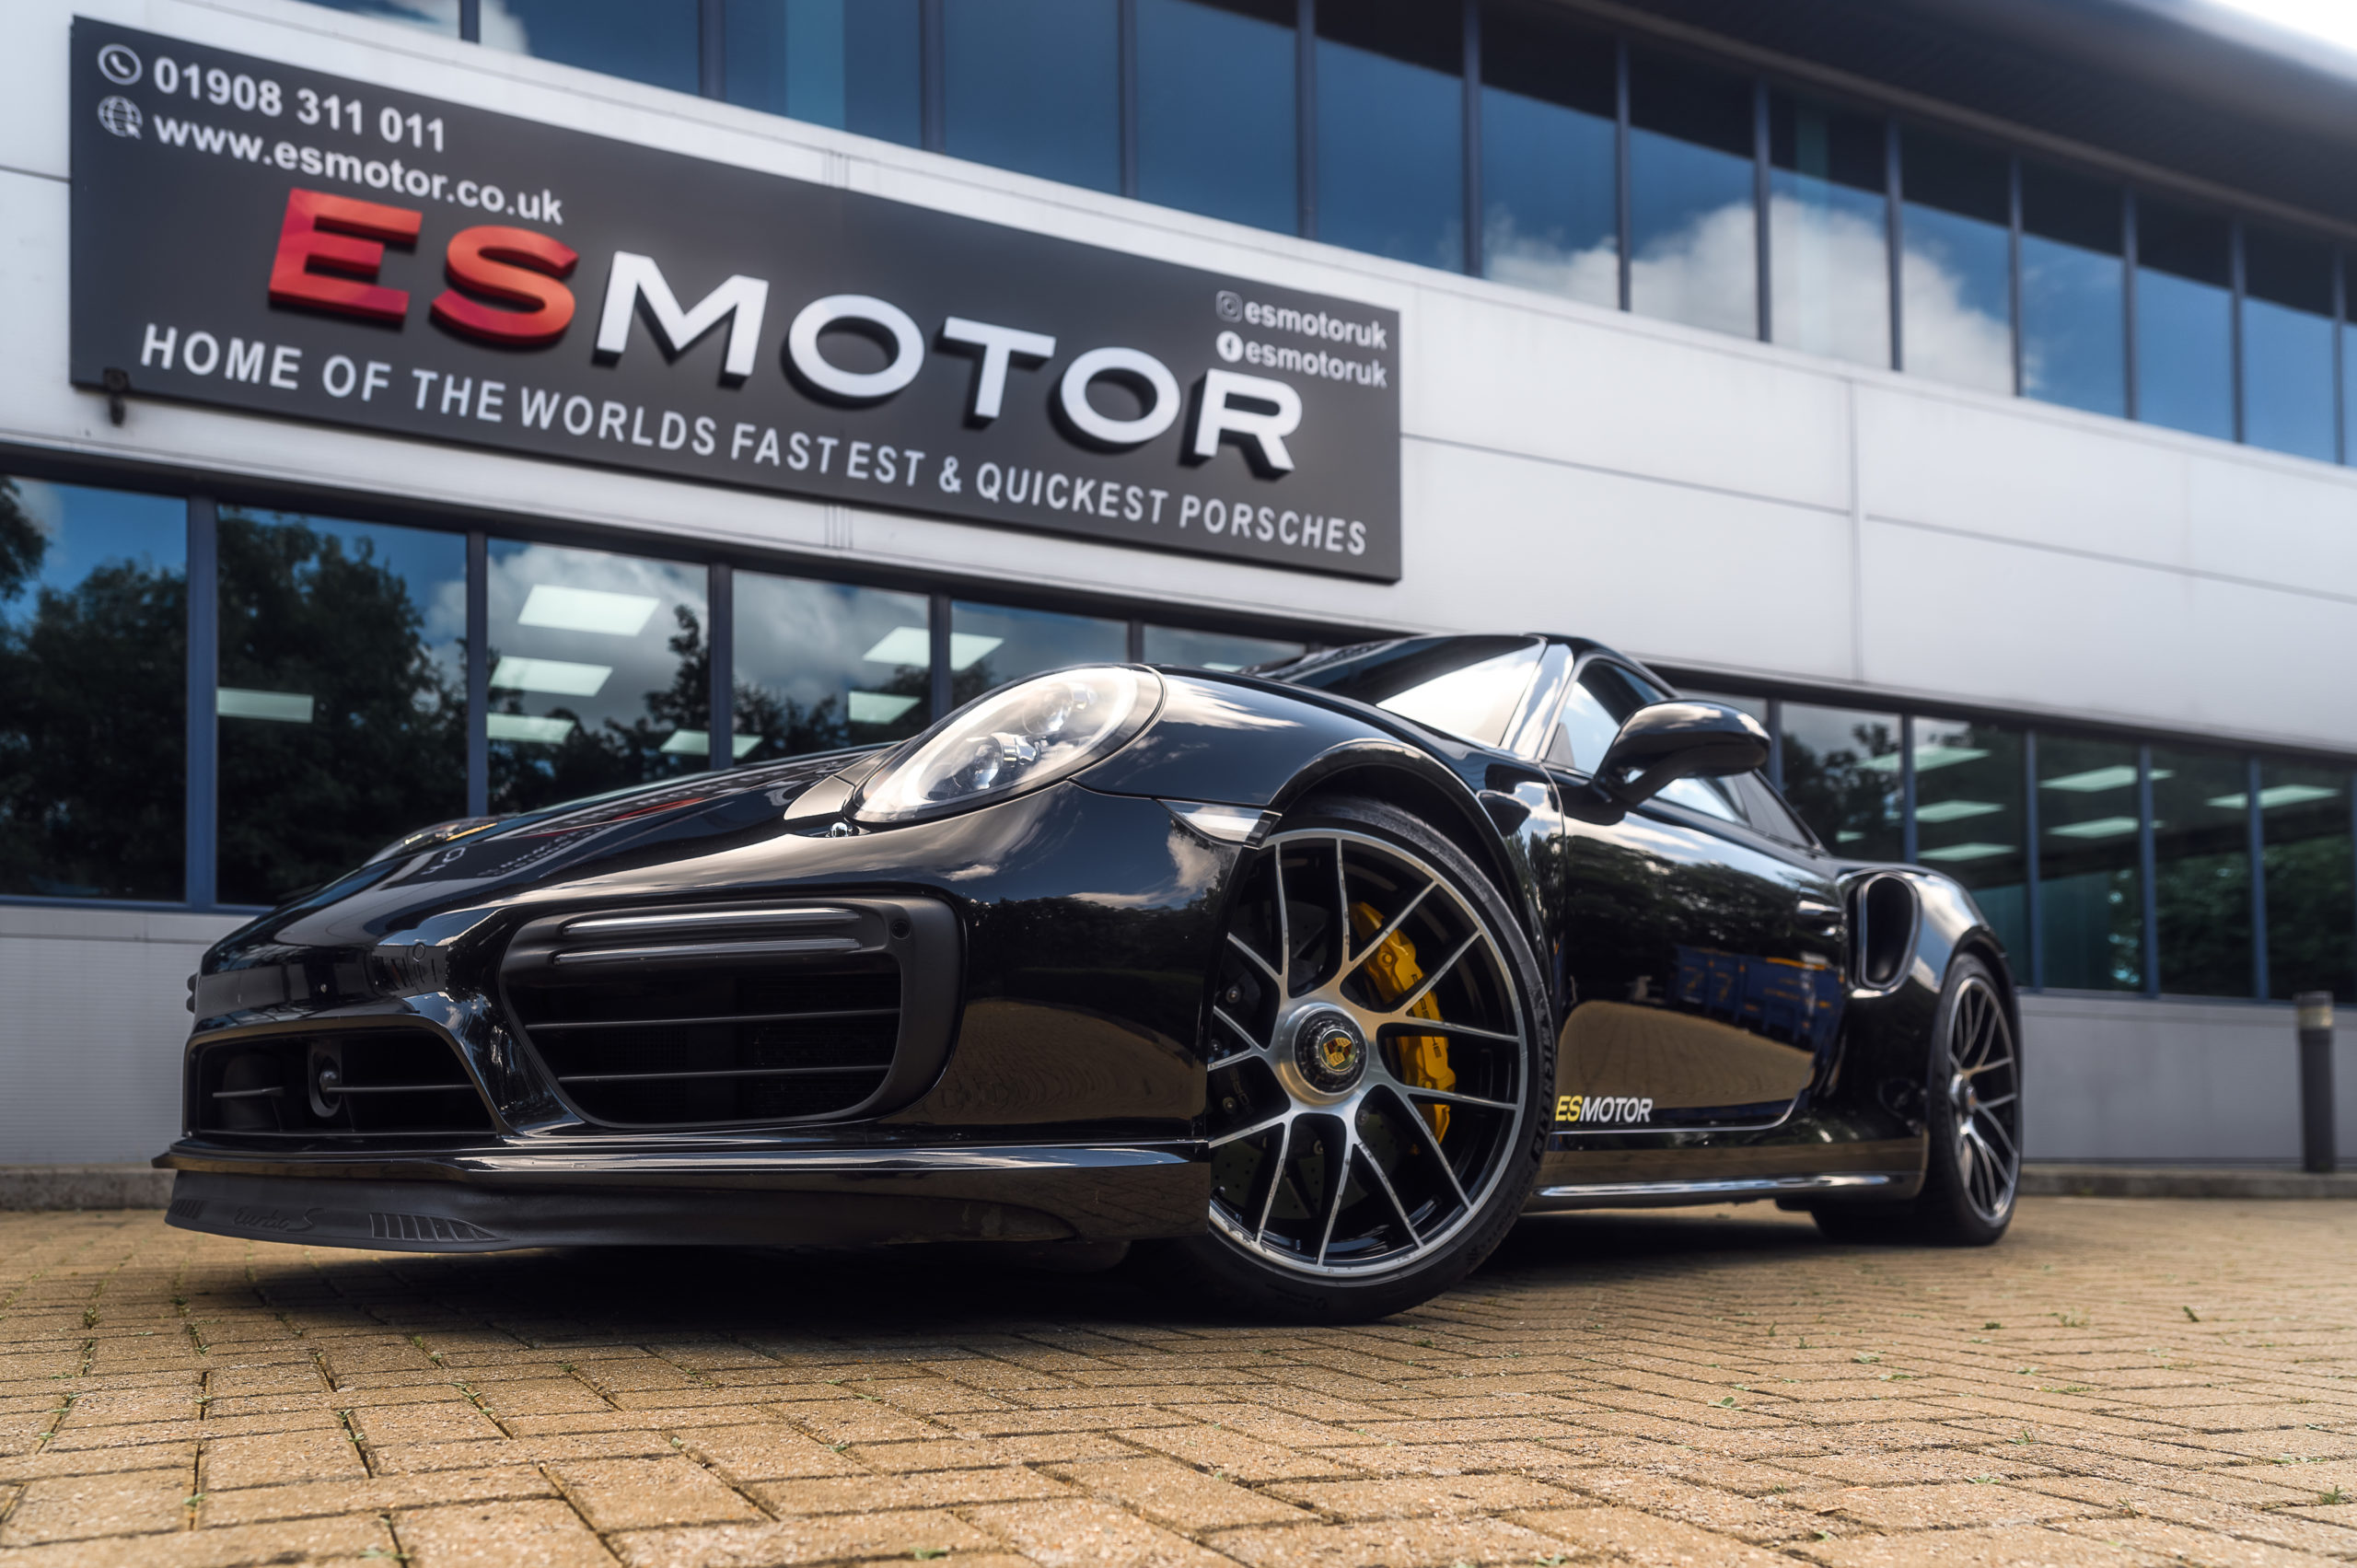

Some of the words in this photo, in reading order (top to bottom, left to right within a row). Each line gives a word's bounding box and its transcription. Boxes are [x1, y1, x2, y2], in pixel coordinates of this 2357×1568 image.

[154, 57, 283, 117] 01908
[296, 87, 363, 135] 311
[379, 107, 445, 153] 011
[154, 114, 563, 226] www.esmotor.co.uk
[268, 188, 1304, 472] ESMOTOR
[1244, 301, 1388, 351] esmotoruk
[1244, 341, 1388, 389] esmotoruk
[141, 323, 302, 389] HOME
[322, 355, 391, 402] OF
[412, 368, 506, 423] THE
[521, 387, 716, 457] WORLDS
[730, 423, 925, 487] FASTEST
[938, 456, 962, 493] &
[976, 462, 1170, 524] QUICKEST
[1178, 494, 1368, 556] PORSCHES
[1555, 1095, 1654, 1123] ESMOTOR
